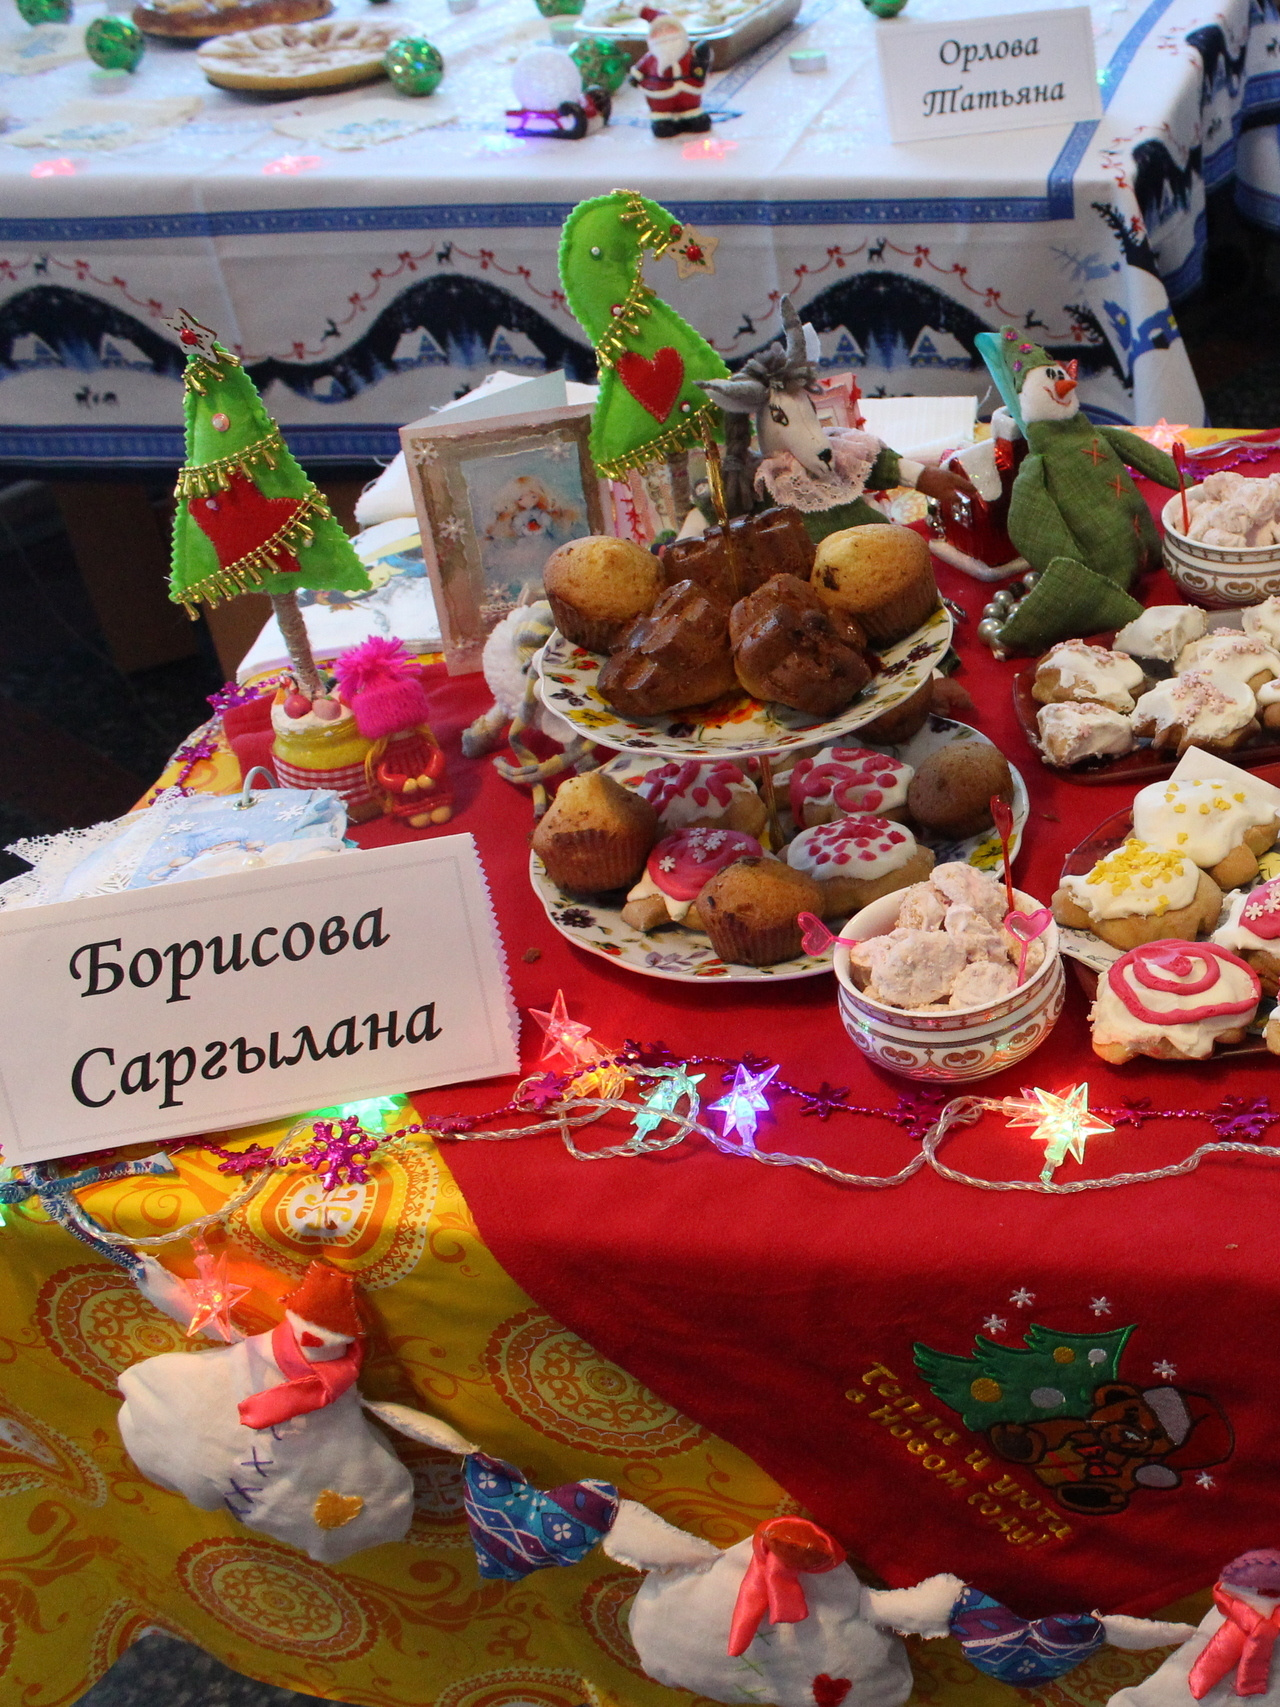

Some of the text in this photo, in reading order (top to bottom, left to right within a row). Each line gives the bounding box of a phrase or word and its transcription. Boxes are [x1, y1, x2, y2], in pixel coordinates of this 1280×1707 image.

[923, 82, 1066, 117] Татьяна
[939, 36, 1040, 72] Орлова
[69, 907, 391, 1003] Борисова
[71, 1001, 443, 1109] Саргылана
[845, 1389, 1050, 1550] в Новом году!
[862, 1362, 1072, 1539] Тепла и уюта
